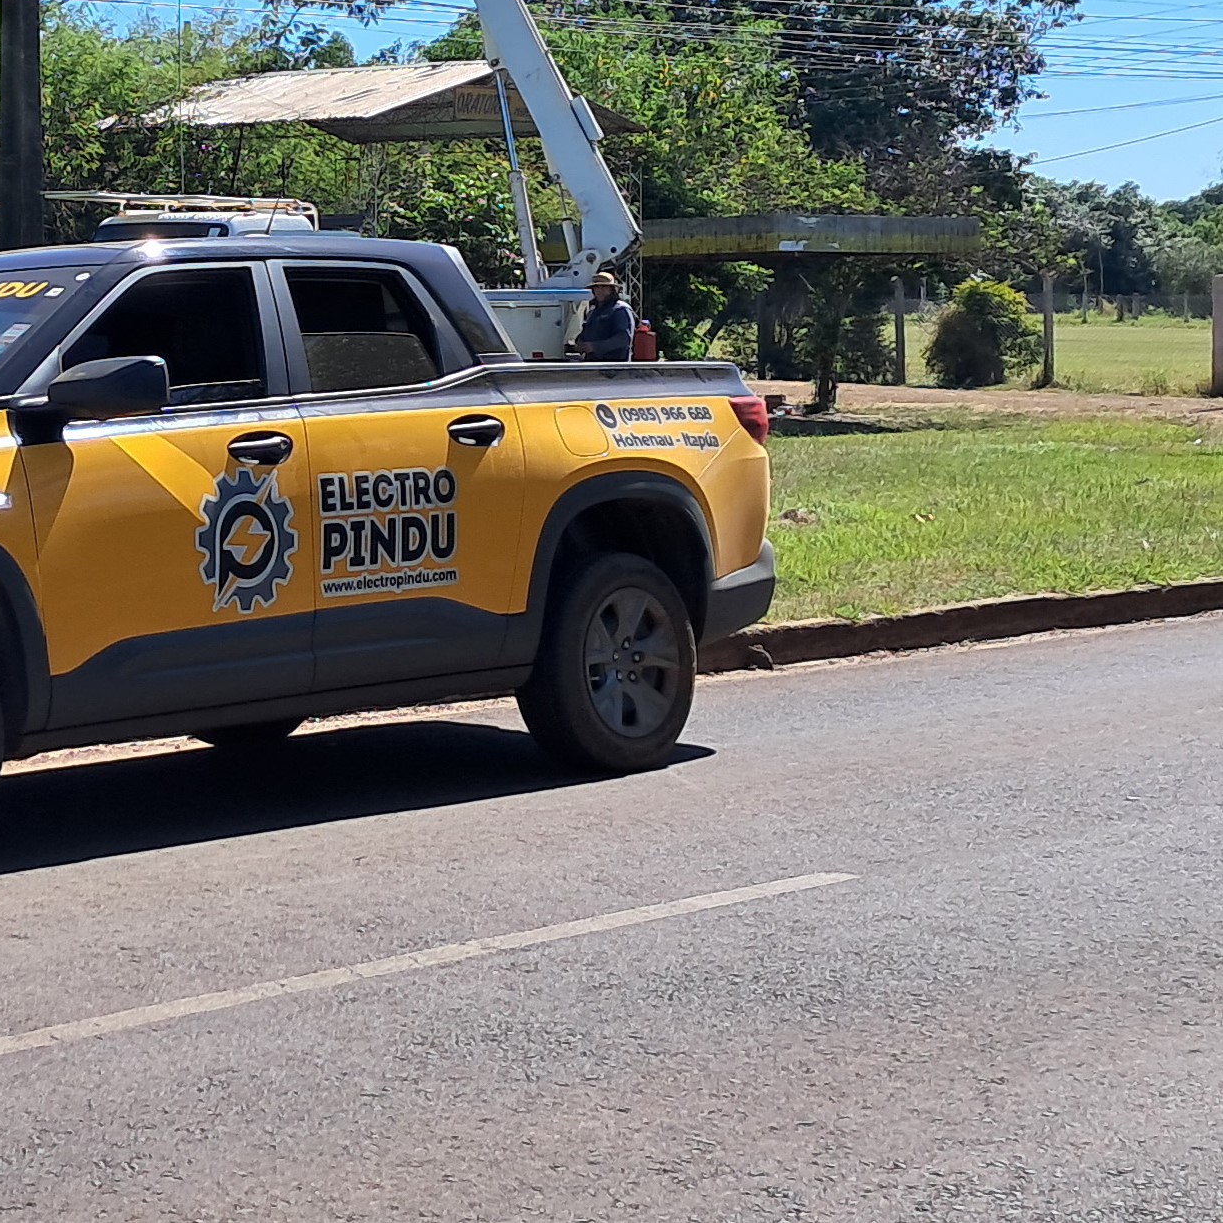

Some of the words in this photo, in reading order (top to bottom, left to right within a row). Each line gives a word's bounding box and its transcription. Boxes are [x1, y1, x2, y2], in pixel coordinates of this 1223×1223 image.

[618, 407, 662, 424] (0985)
[661, 407, 687, 420] 966
[613, 432, 674, 448] Hohenau
[681, 432, 720, 450] Itapúa
[320, 470, 456, 512] ELECTRO
[322, 513, 455, 569] PINDU
[322, 570, 457, 593] www.electropindu.com
